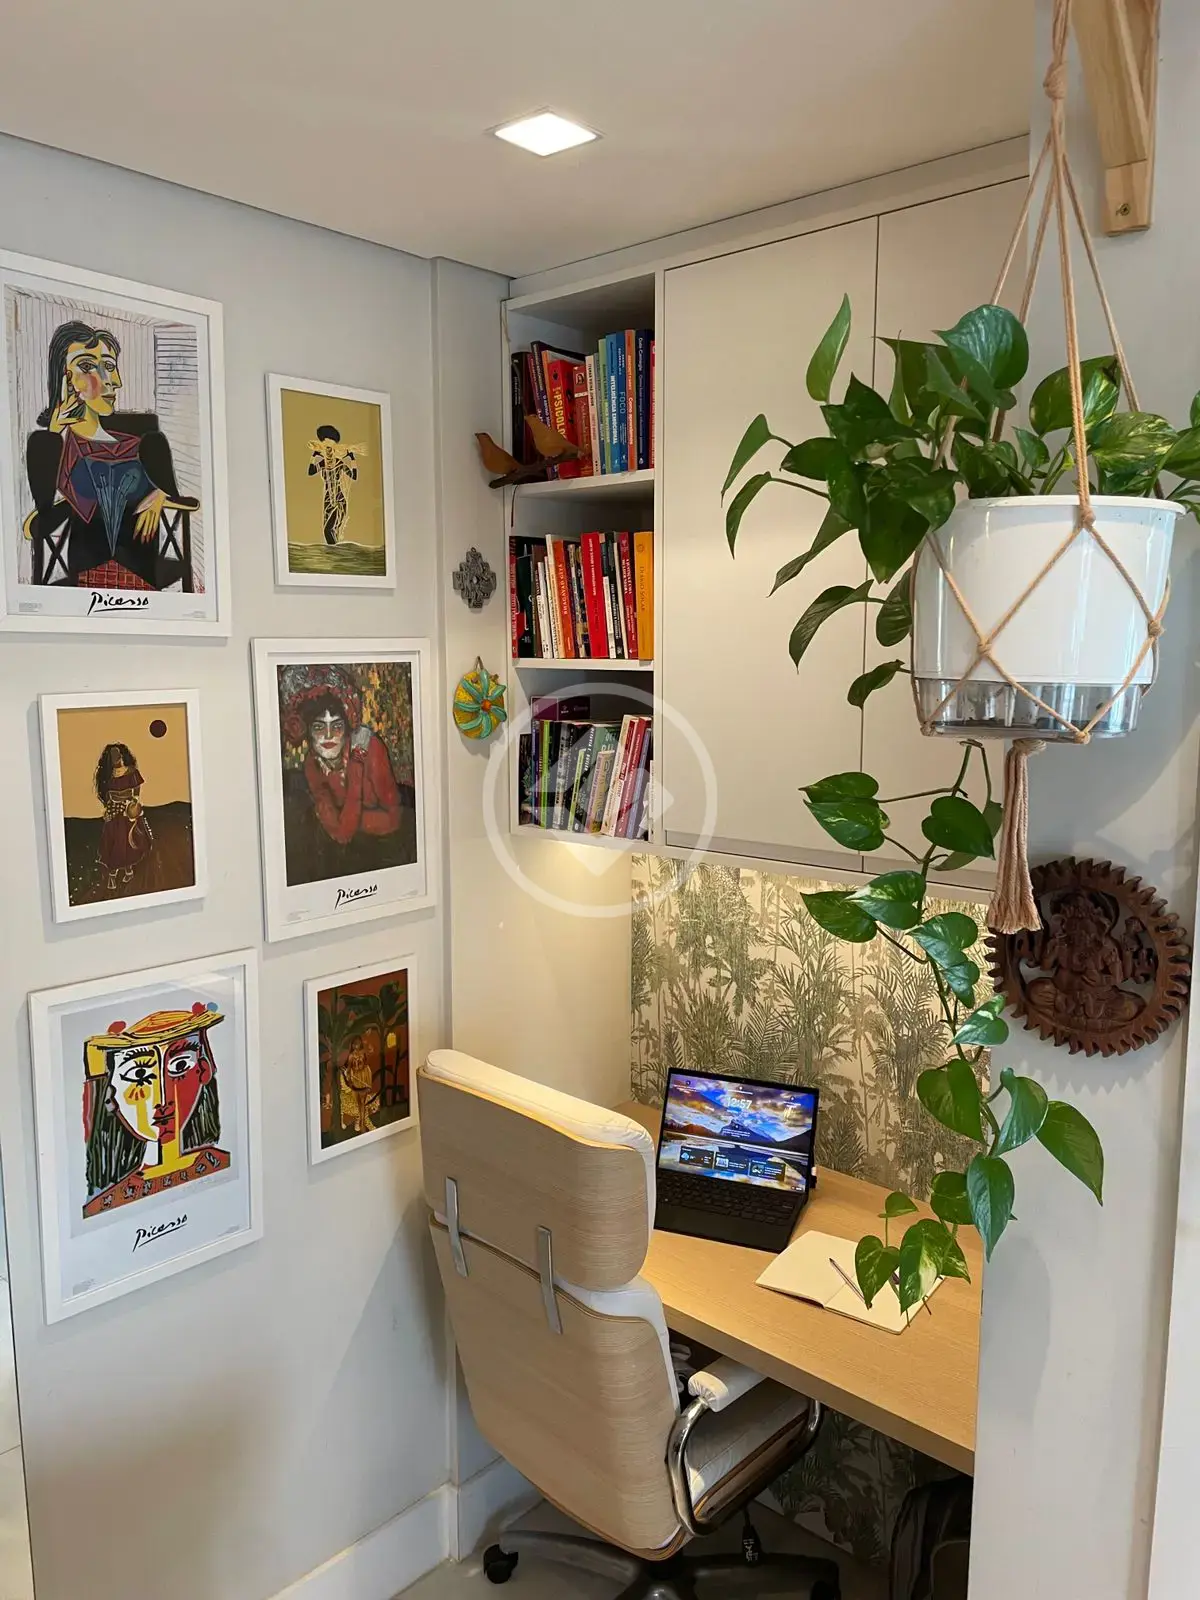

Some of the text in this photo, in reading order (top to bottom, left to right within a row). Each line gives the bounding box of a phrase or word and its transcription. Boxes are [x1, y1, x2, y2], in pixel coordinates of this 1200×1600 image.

[554, 394, 567, 440] PSICOLO
[87, 592, 149, 616] Picasso
[560, 580, 568, 614] BHAGAVAD
[583, 754, 592, 771] BUTLER
[334, 884, 378, 910] Picasso
[132, 1214, 188, 1253] Picasso
